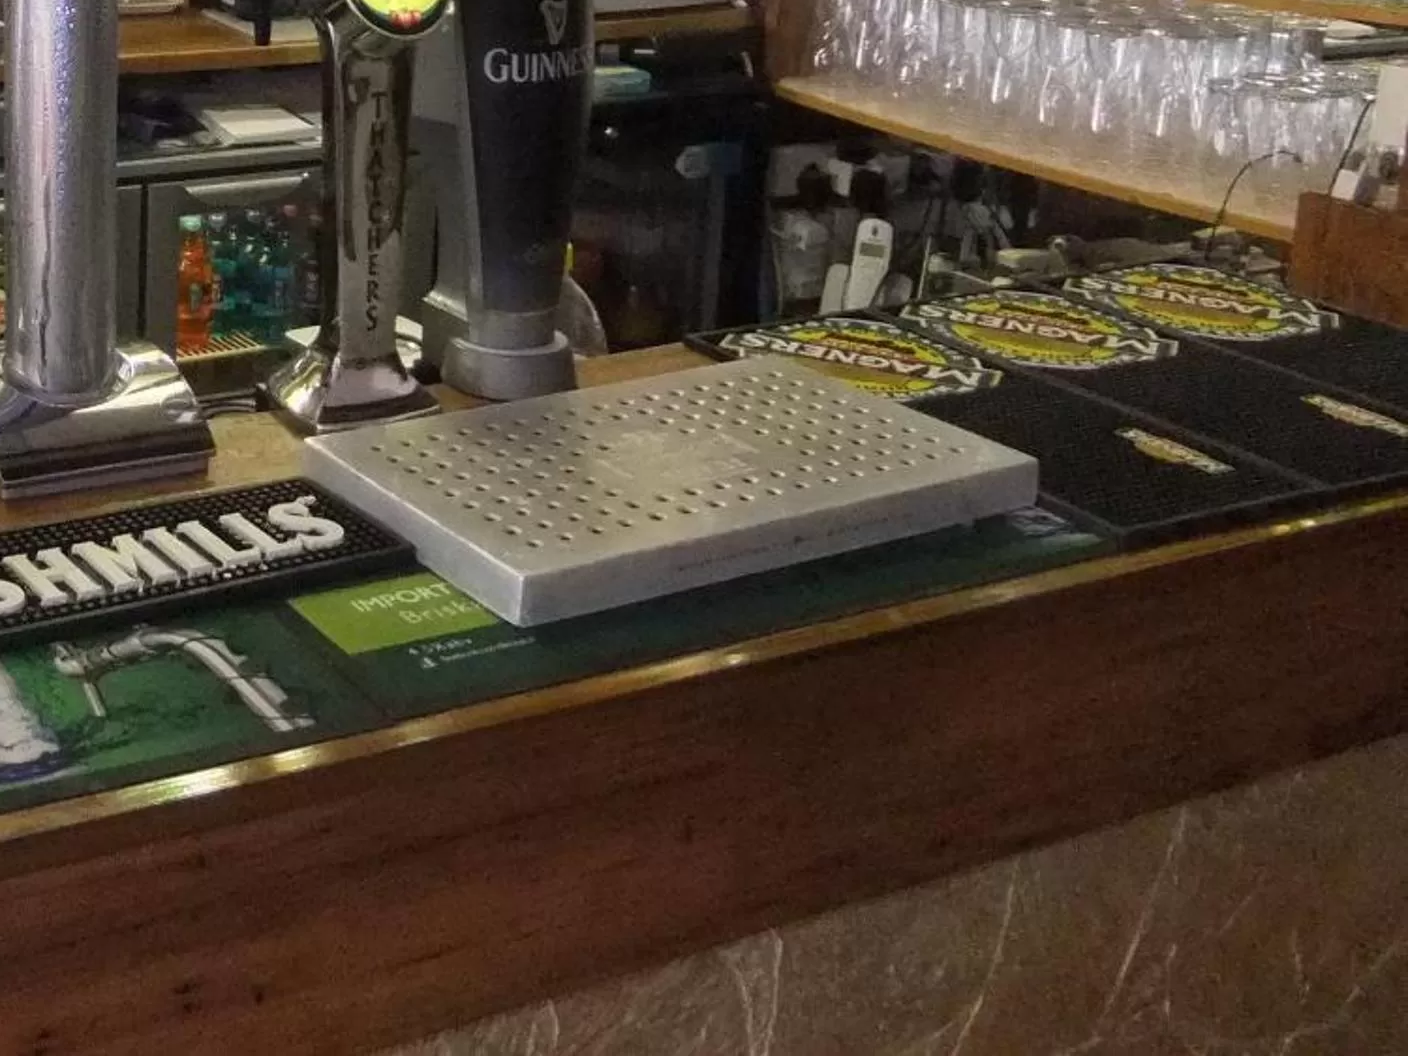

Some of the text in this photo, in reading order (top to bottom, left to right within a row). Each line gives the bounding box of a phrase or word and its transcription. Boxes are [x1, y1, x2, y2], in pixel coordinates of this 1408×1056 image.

[483, 46, 591, 83] GUINNE
[365, 92, 388, 332] THATCHERS
[1082, 276, 1320, 328] MAGNERS
[918, 303, 1160, 356] MAGNERS
[740, 331, 982, 387] MAGNERS
